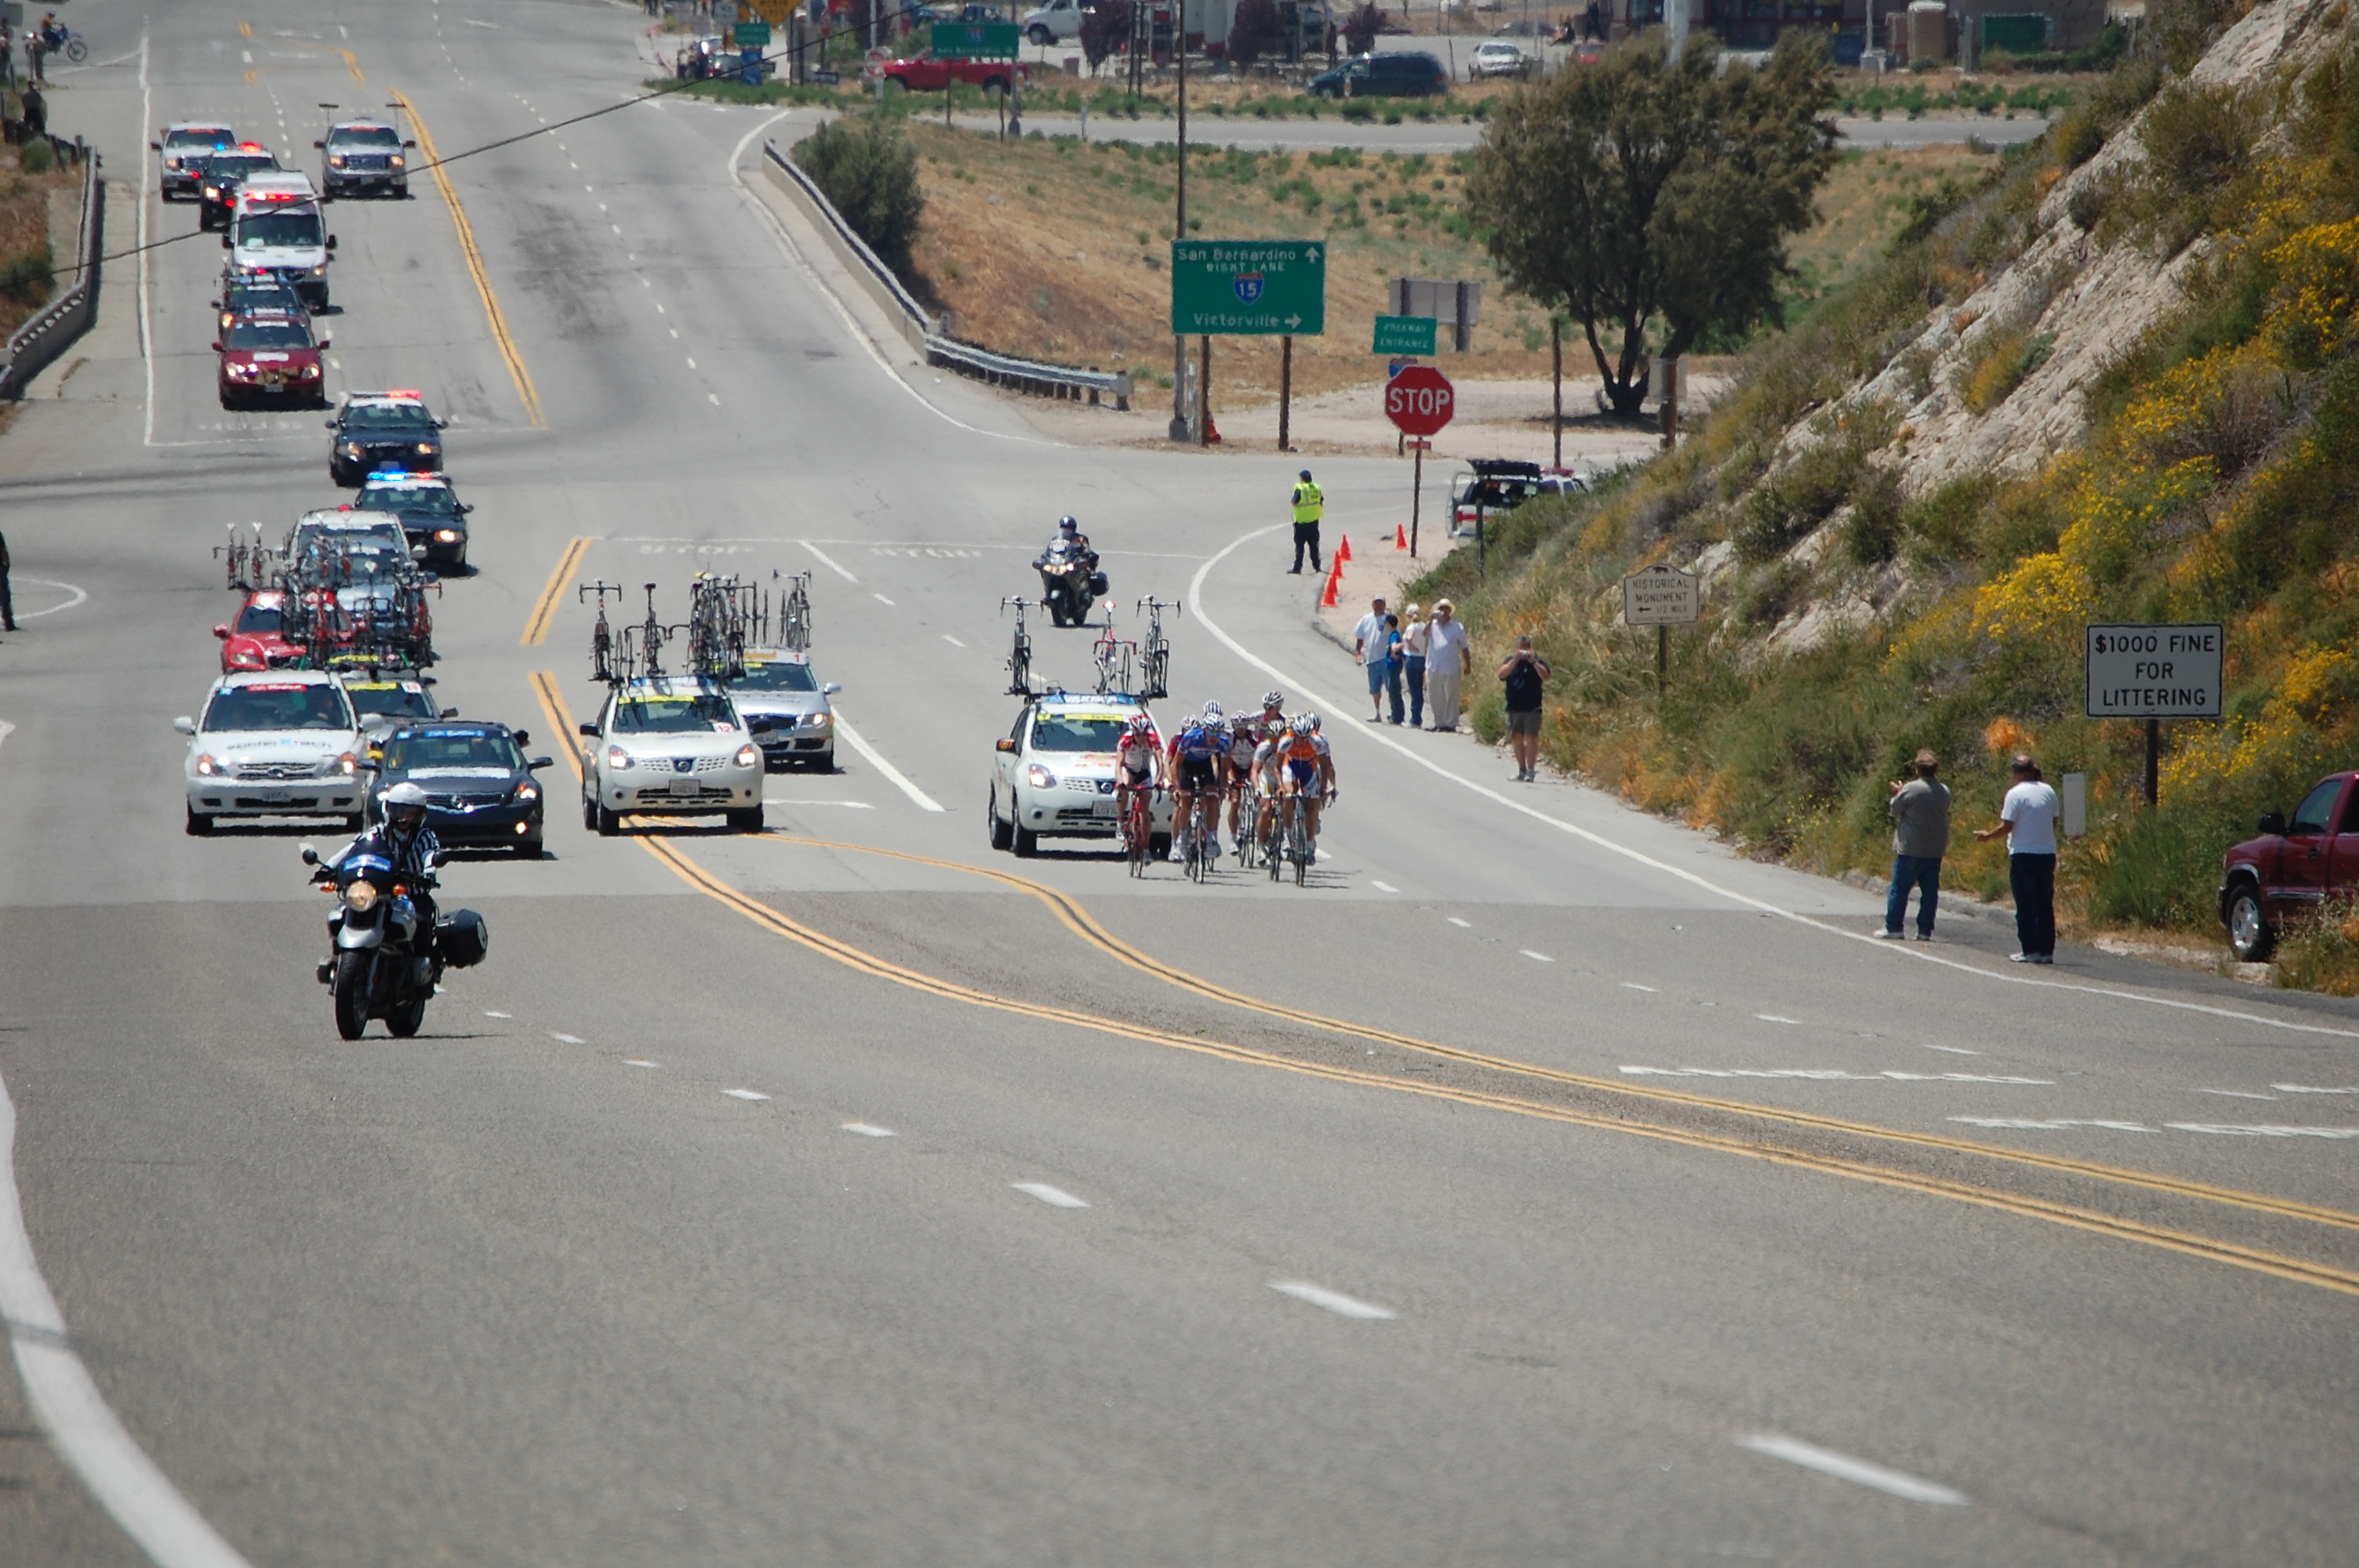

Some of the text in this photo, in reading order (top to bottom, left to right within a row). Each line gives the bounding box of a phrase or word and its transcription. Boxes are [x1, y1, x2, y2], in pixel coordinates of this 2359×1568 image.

[1178, 249, 1296, 261] San Bernardino
[1207, 263, 1285, 272] RIGHT LANE
[1239, 281, 1257, 297] 15
[1193, 313, 1279, 327] Victorville
[1383, 323, 1427, 332] FREEWAY
[1380, 338, 1429, 348] ENTRANCE
[1388, 387, 1450, 416] STOP
[1632, 579, 1689, 590] HISTORICAL
[1635, 592, 1688, 603] MONUMENT
[2095, 634, 2215, 654] $1000 FINE
[2135, 662, 2174, 680] FOR
[1063, 695, 1118, 705] YAKIMA
[2103, 688, 2206, 706] LITTERING
